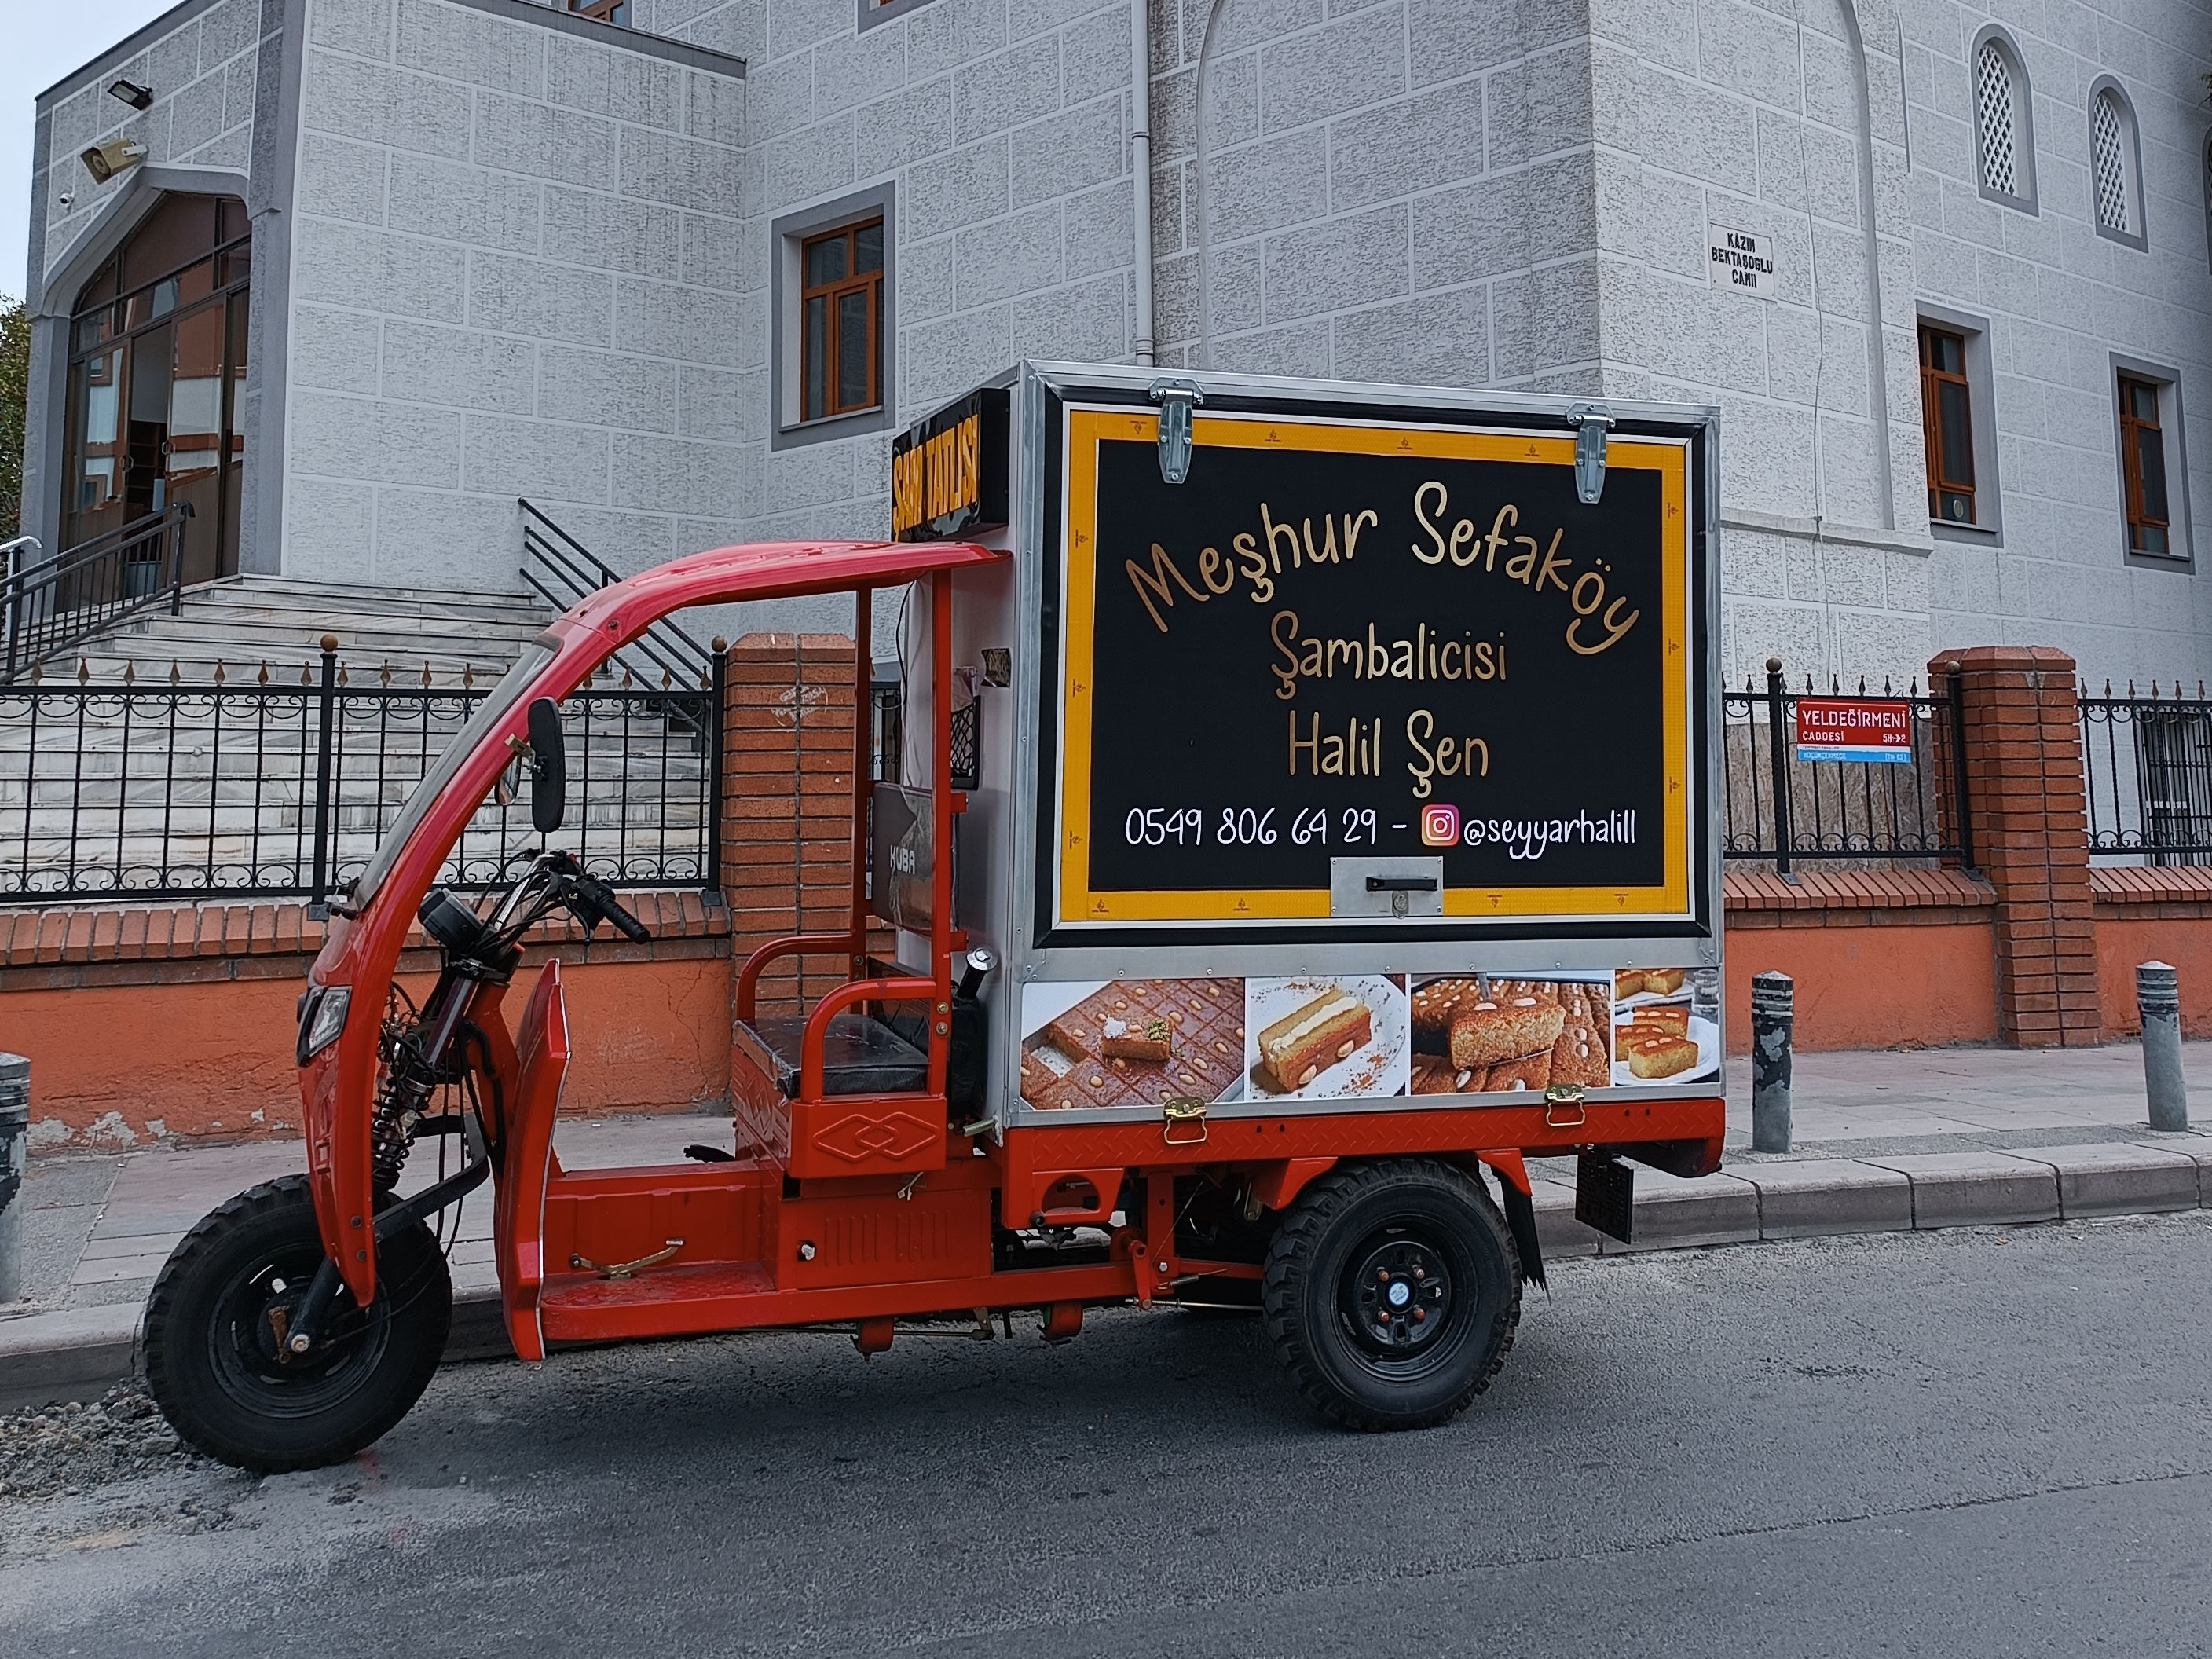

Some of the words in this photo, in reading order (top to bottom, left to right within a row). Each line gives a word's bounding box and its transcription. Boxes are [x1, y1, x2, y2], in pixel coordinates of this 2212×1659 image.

[925, 413, 980, 521] TATLISI
[1125, 502, 1378, 633] Meşhur
[1411, 481, 1639, 655] Sefaköy
[1271, 610, 1507, 700] Şambalicisi
[1289, 709, 1382, 777] Halil
[1406, 709, 1489, 799] Şen
[1801, 709, 1906, 728] YELDEĞİRMENİ
[1802, 731, 1844, 742] CADDESİ
[890, 845, 915, 875] KUBA
[1125, 808, 1203, 847] 0549
[1216, 808, 1278, 846] 806
[1291, 807, 1327, 845] 64
[1342, 808, 1376, 845] 29
[1463, 808, 1636, 859] @seyyarhalill
